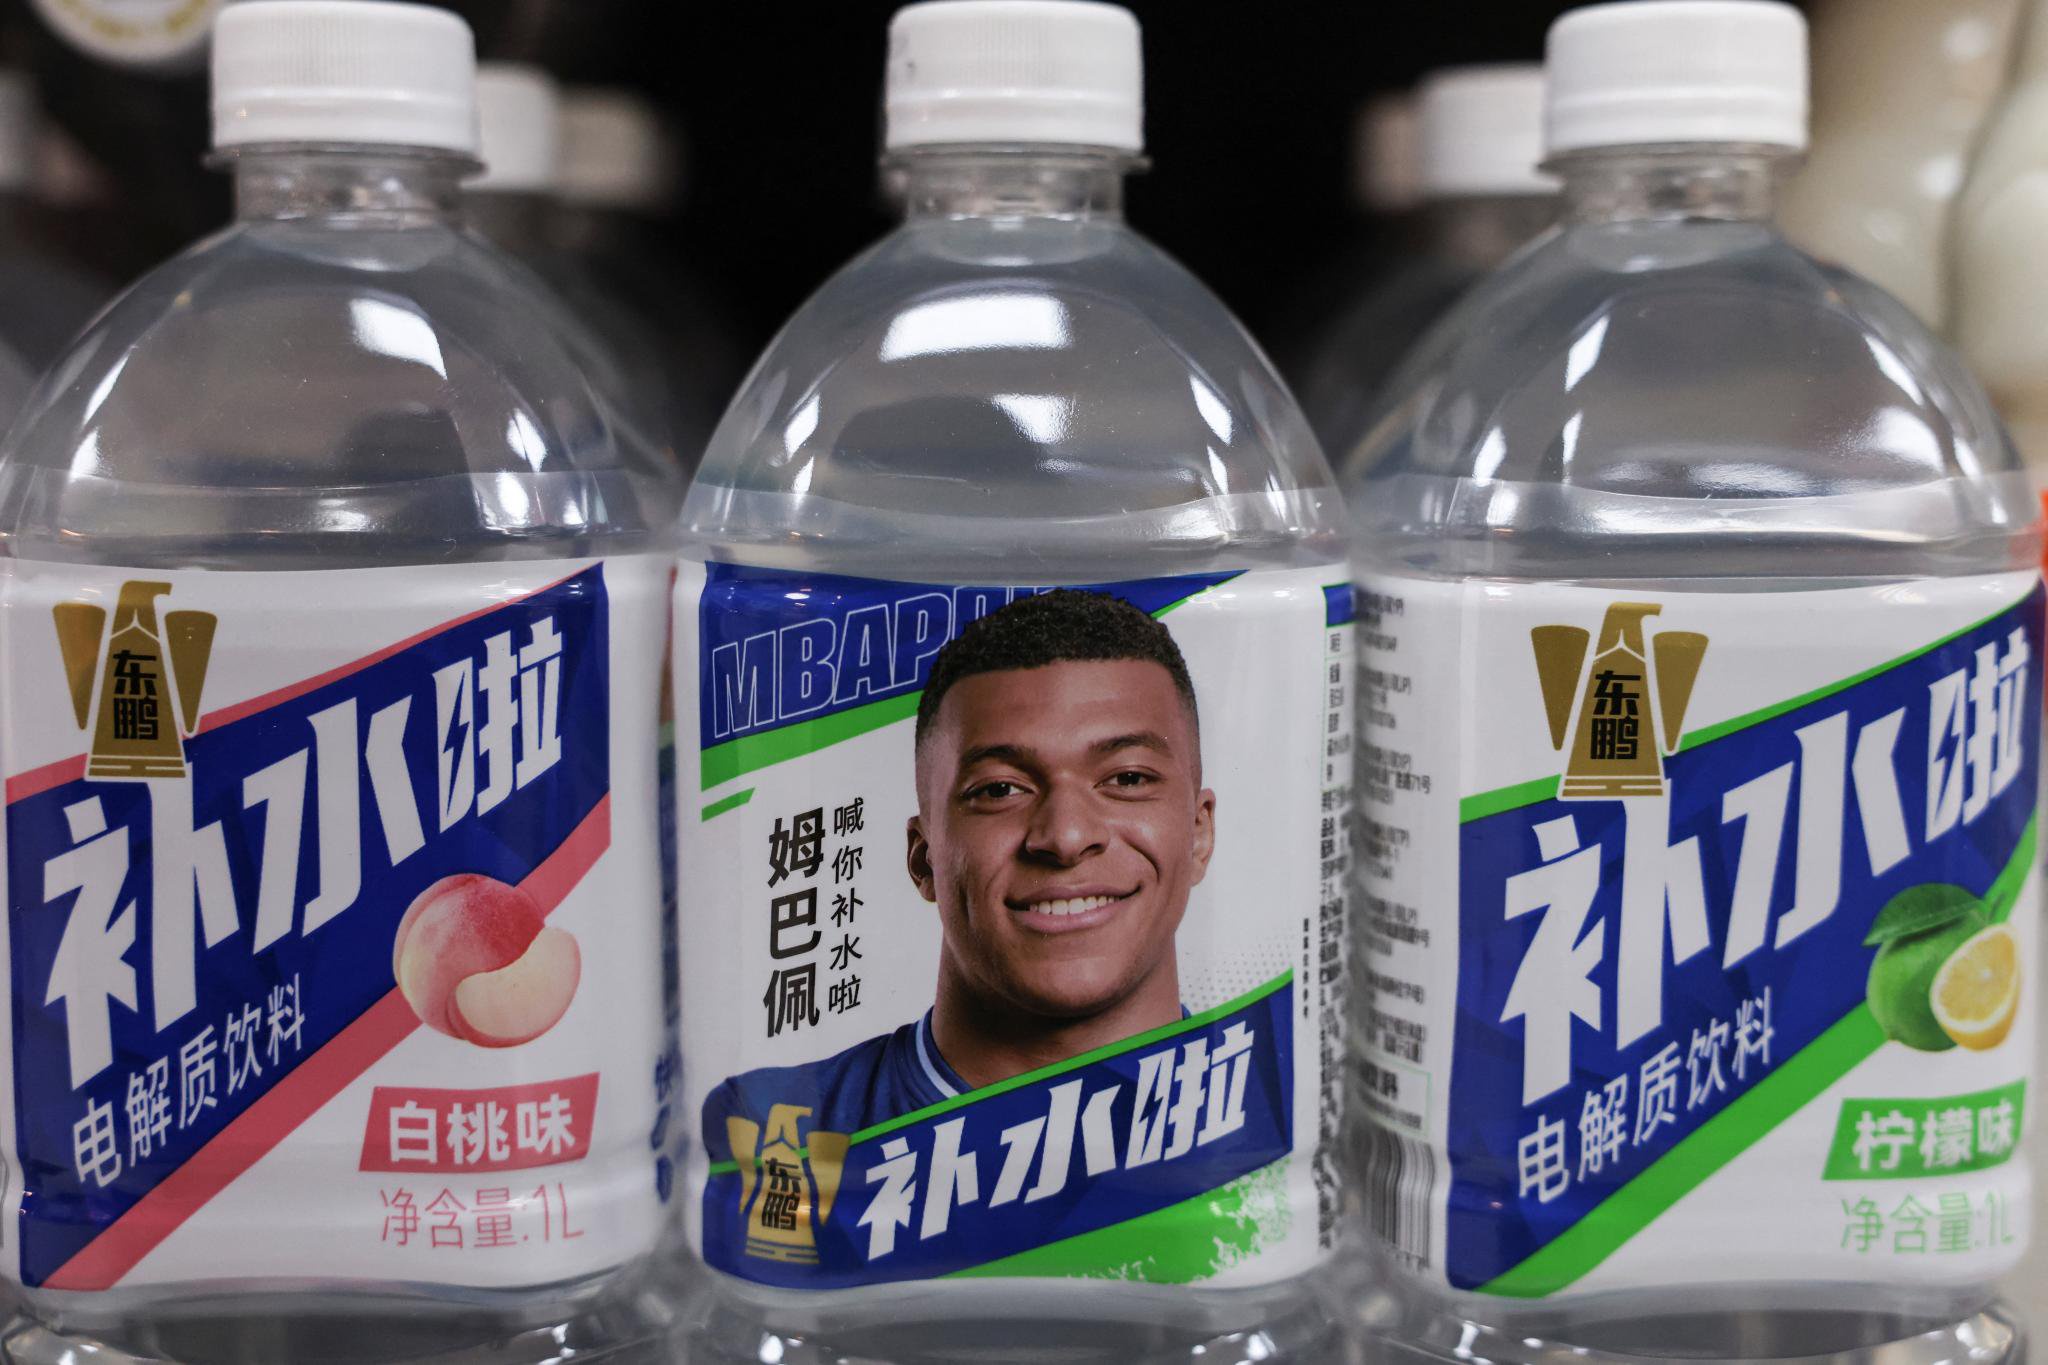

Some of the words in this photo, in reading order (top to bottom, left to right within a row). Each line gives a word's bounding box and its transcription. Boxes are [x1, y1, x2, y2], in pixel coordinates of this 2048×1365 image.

[113, 648, 158, 741] 东鹏
[712, 585, 1058, 739] MBAP
[1589, 669, 1642, 761] 东鹏
[44, 615, 563, 1090] 补水啦
[763, 806, 826, 1038] 姆巴佩
[828, 797, 865, 1015] 喊你补水啦
[1499, 625, 2032, 1107] 补水啦
[73, 973, 305, 1189] 电解质饮料
[389, 1093, 576, 1165] 白桃味
[856, 1020, 1255, 1262] 补水啦
[1518, 986, 1774, 1204] 电解质饮料
[1852, 1098, 2015, 1172] 柠檬味
[761, 1156, 802, 1232] 东鹏
